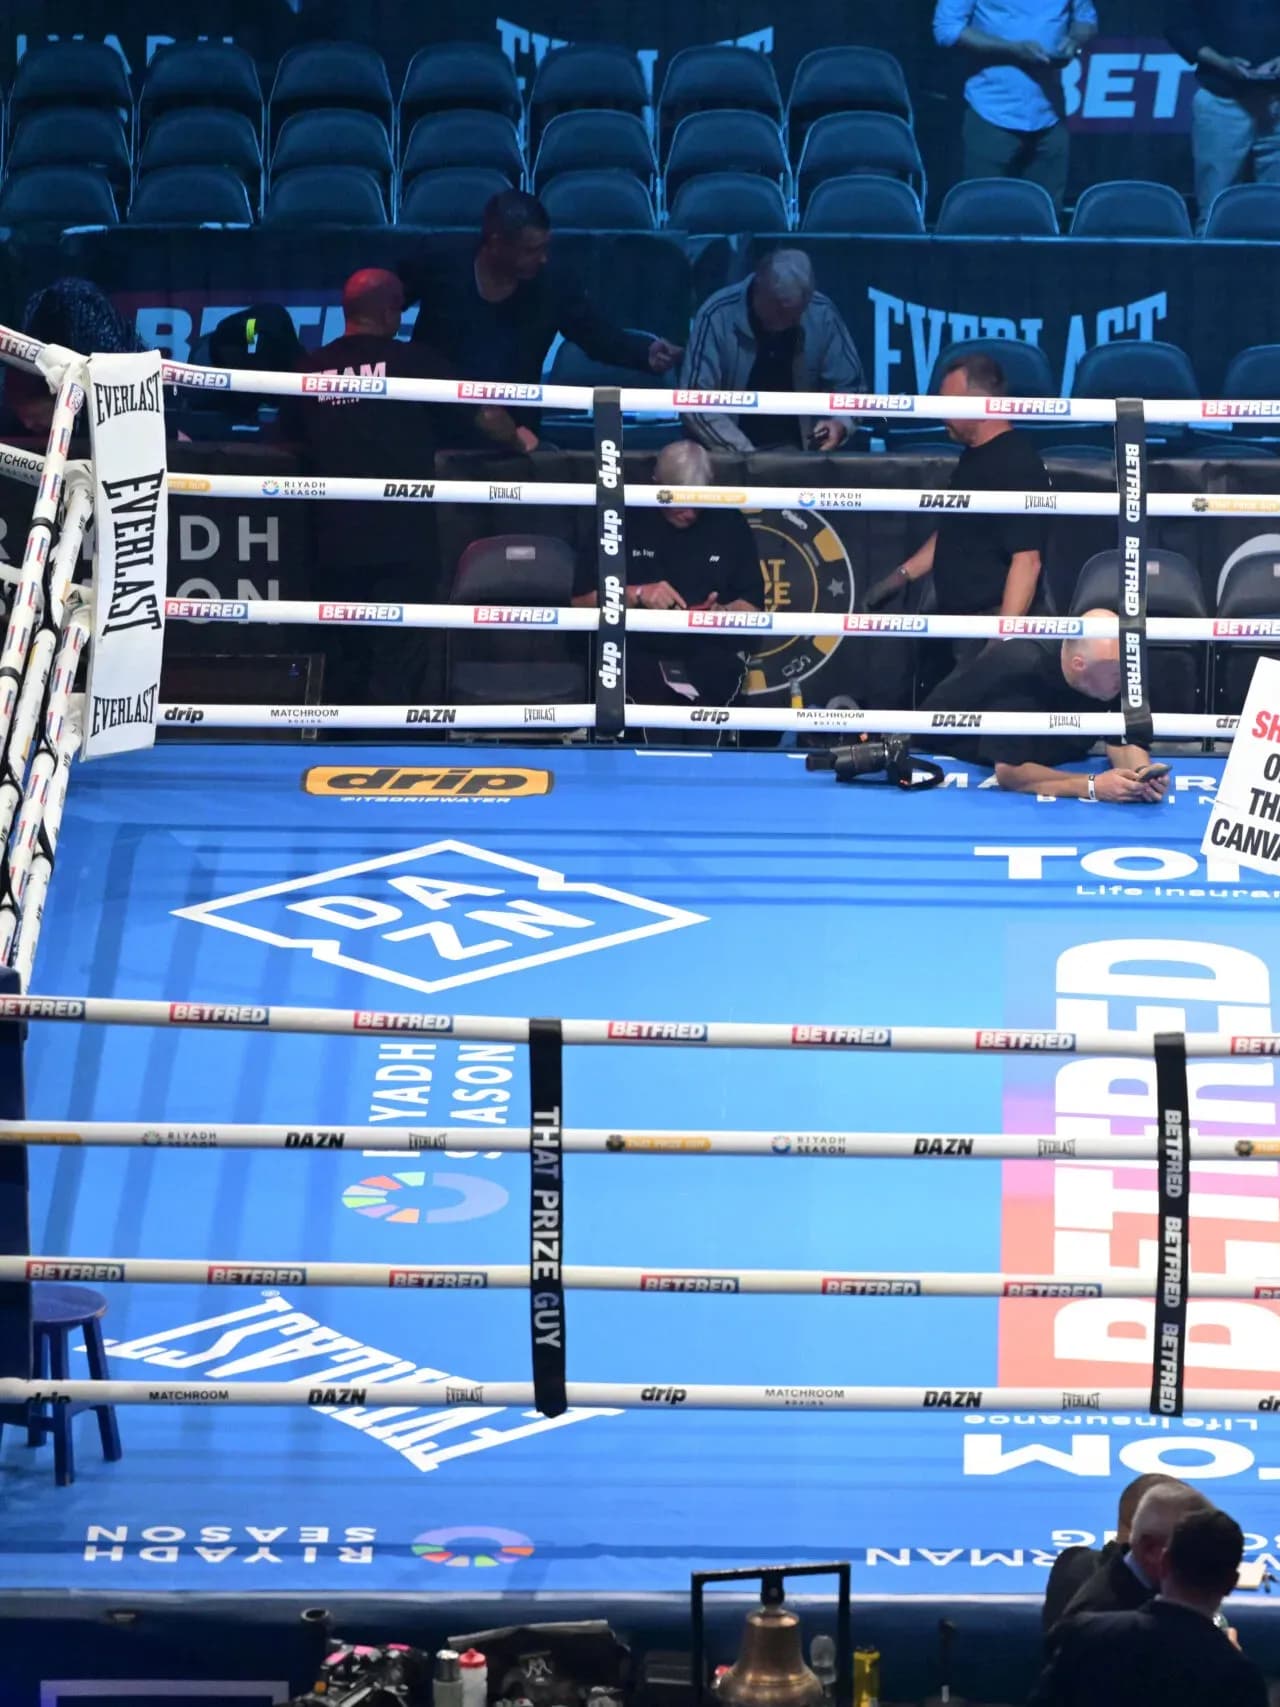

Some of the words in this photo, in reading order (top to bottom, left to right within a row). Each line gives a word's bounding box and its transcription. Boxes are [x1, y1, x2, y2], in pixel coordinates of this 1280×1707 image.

[164, 366, 228, 389] ETFRED
[305, 377, 384, 393] BETFRED
[93, 370, 161, 425] EVERLAST
[460, 383, 540, 400] BETFRED
[675, 391, 756, 406] BETFRED
[832, 394, 912, 411] BETFRED
[988, 399, 1068, 414] BETFRED
[599, 439, 621, 489] drip
[383, 483, 435, 498] DAZN
[1124, 443, 1140, 523] BETFRED
[489, 485, 521, 501] EVERLAST
[919, 493, 970, 508] DAZN
[1025, 494, 1057, 510] EVERLAST
[599, 509, 622, 555] drip
[102, 469, 164, 636] EVERLAST
[1126, 536, 1140, 616] BETFRED
[600, 575, 624, 625] drip
[166, 603, 245, 618] BETFRED
[322, 605, 401, 621] BETFRED
[476, 608, 556, 623] BETFRED
[691, 612, 771, 627] BETFRED
[847, 616, 926, 631] BETFRED
[1002, 619, 1081, 634] BETFRED
[599, 641, 621, 689] drip
[1126, 632, 1143, 708] BETFRED
[91, 684, 158, 738] EVERLAST
[164, 706, 204, 723] drip
[270, 709, 339, 717] MATCHROOM
[406, 709, 456, 723] DAZN
[524, 707, 556, 723] EVERLAST
[690, 708, 729, 725] drip
[932, 714, 982, 728] DAZN
[1049, 713, 1081, 729] EVERLAST
[327, 769, 528, 794] drip
[1076, 885, 1143, 896] Life
[172, 1005, 267, 1023] BETFRED
[357, 1013, 451, 1031] BETFRED
[610, 1022, 705, 1040] BETFRED
[795, 1027, 889, 1044] BETFRED
[979, 1032, 1074, 1050] BETFRED
[362, 1044, 437, 1157] YADH
[444, 1044, 516, 1159] ASON
[285, 1133, 344, 1149] DAZN
[408, 1133, 447, 1150] EVERLAST
[532, 1106, 559, 1178] THAT
[914, 1138, 973, 1155] DAZN
[1037, 1138, 1076, 1157] EVERLAST
[1165, 1109, 1182, 1198] BETFRED
[532, 1190, 559, 1280] PRIZE
[1164, 1216, 1182, 1308] BETFRED
[30, 1265, 123, 1281] BETFRED
[212, 1268, 305, 1285] BETFRED
[394, 1272, 486, 1287] BETFRED
[645, 1277, 738, 1293] BETFRED
[826, 1281, 919, 1296] BETFRED
[533, 1292, 561, 1349] GUY
[1160, 1323, 1179, 1414] BETFRED
[149, 1391, 229, 1399] MATCHROOM
[307, 1388, 366, 1406] DAZN
[446, 1386, 484, 1404] EVERLAST
[640, 1386, 687, 1405] drip
[766, 1389, 845, 1398] MATCHROOM
[923, 1391, 983, 1408] DAZN
[1062, 1392, 1100, 1410] EVERLAST
[964, 1413, 1170, 1428] Insurance
[1184, 1416, 1258, 1431] Life
[86, 1525, 376, 1543] SEASON
[83, 1546, 375, 1563] RIYADH
